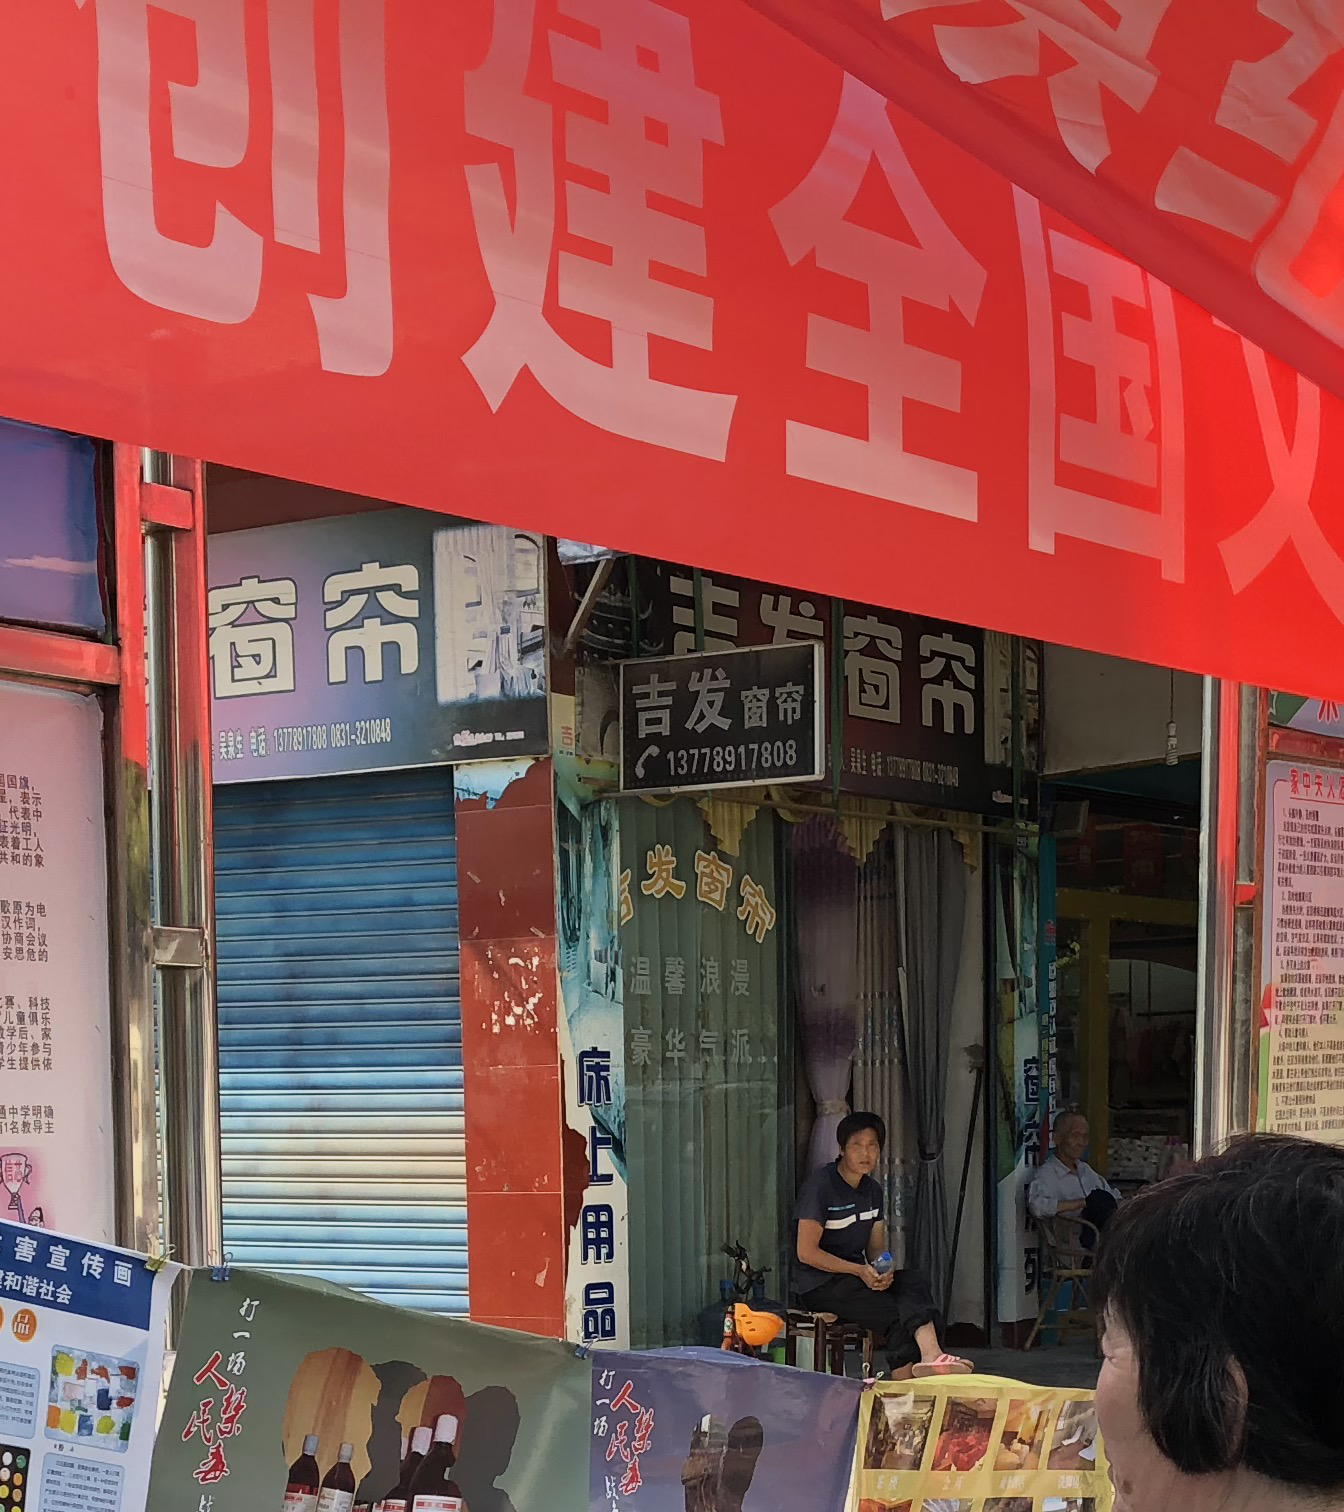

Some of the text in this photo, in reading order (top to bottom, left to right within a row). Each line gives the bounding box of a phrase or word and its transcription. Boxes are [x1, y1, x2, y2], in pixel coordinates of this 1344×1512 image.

[208, 561, 420, 699] 窗帘
[632, 666, 806, 739] 吉发窗帘
[666, 740, 797, 776] 13778917808
[630, 956, 751, 997] 温馨浪漫
[576, 1046, 616, 1343] 床上用品
